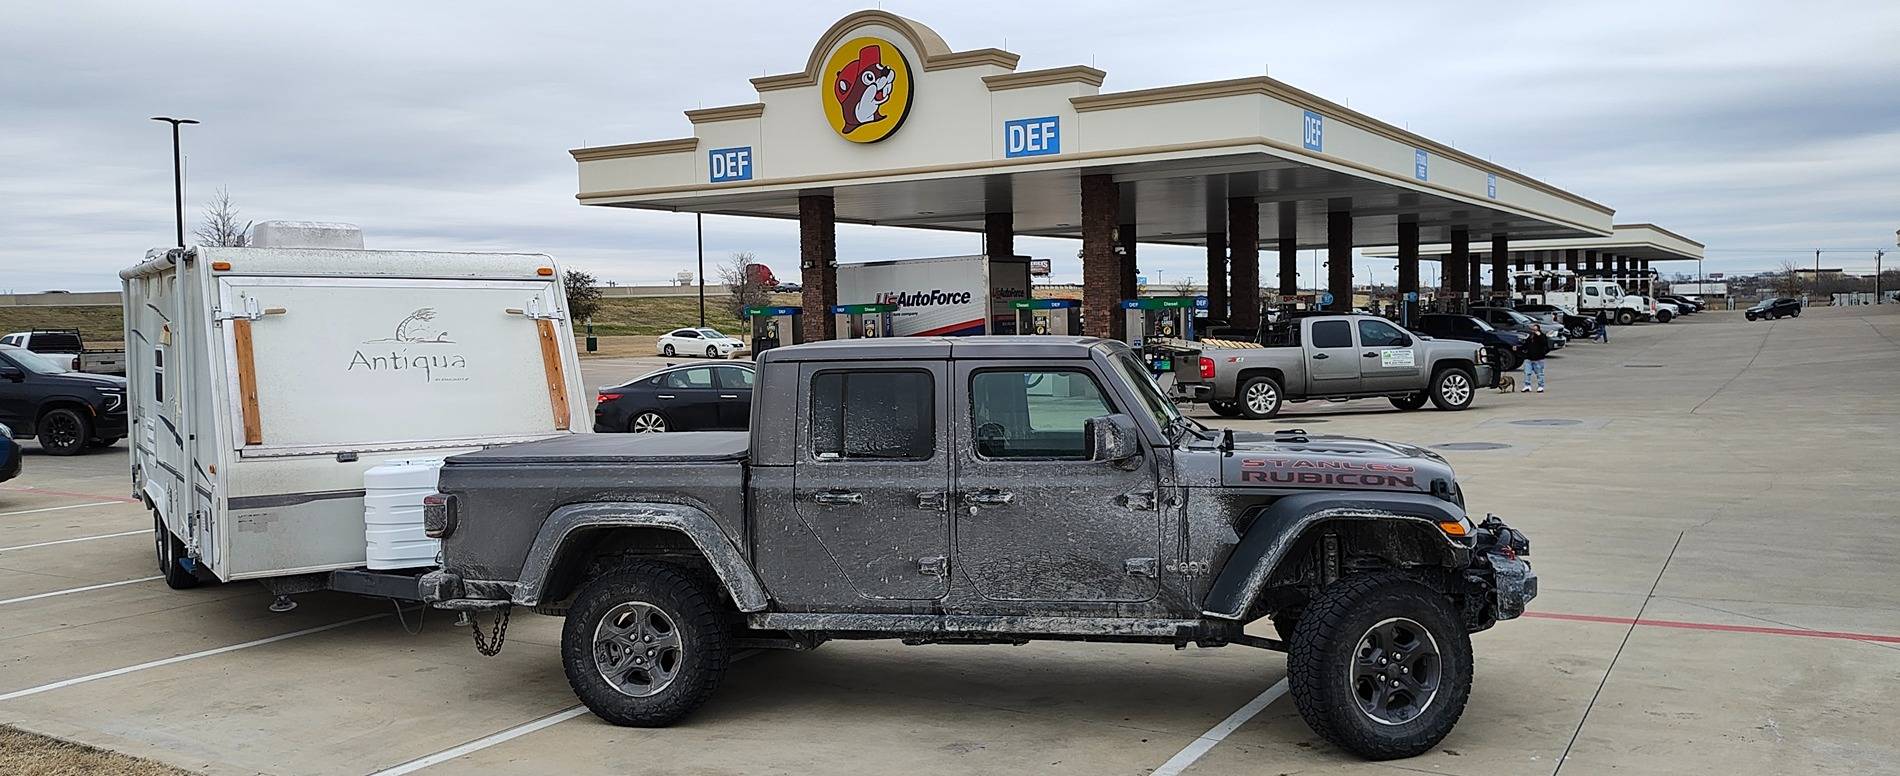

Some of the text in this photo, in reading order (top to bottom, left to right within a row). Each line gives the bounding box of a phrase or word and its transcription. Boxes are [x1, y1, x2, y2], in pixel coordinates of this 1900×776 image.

[1009, 121, 1055, 153] DEF
[1304, 115, 1321, 147] DEF
[712, 151, 749, 179] DEF
[1241, 457, 1416, 473] STANLEY
[1241, 470, 1415, 487] RUBICON
